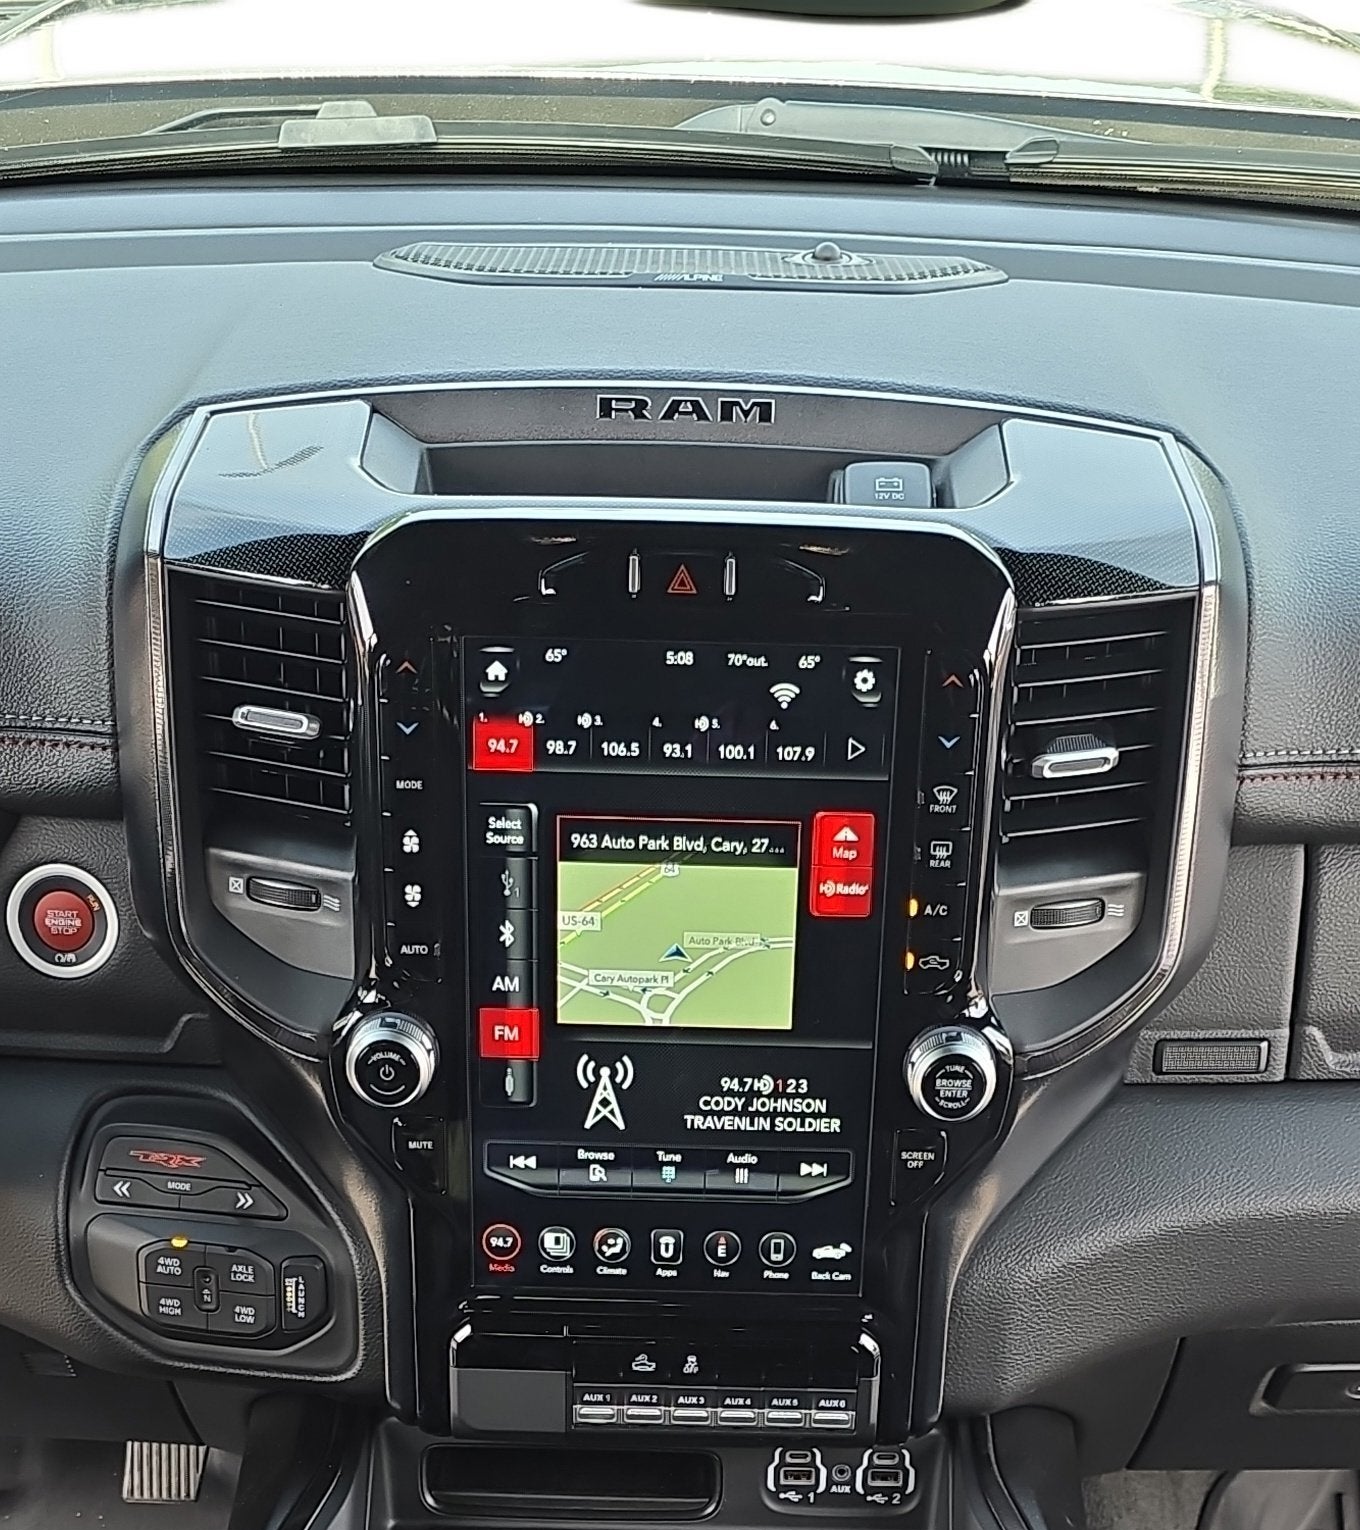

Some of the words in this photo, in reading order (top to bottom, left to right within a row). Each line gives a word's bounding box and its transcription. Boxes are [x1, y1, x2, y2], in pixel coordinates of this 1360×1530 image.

[596, 394, 776, 424] RAM
[874, 492, 890, 500] 12V
[892, 492, 905, 500] DC
[545, 648, 568, 662] 65°
[665, 651, 694, 665] 5:08
[798, 655, 821, 669] 65°
[487, 738, 519, 753] 94.7
[546, 740, 577, 755] 98.7
[601, 741, 640, 757] 106.5
[663, 743, 692, 759] 93.1
[718, 744, 755, 760] 100.1
[776, 745, 815, 761] 107.9
[396, 780, 424, 790] MODE
[929, 804, 957, 813] FRONT
[488, 816, 522, 830] Select
[485, 832, 525, 845] Source
[570, 833, 598, 849] 963
[601, 834, 635, 850] Auto
[639, 836, 669, 850] Park
[673, 836, 707, 854] Blvd,
[710, 837, 748, 855] Cary,
[832, 847, 857, 861] Map
[929, 860, 952, 868] REAR
[46, 910, 78, 918] START
[924, 904, 948, 916] A/C
[45, 918, 82, 927] ENGINE
[562, 916, 595, 926] US-64
[50, 926, 78, 935] STOP
[688, 935, 712, 946] Auto
[713, 936, 734, 946] Park
[400, 945, 429, 955] AUTO
[492, 976, 520, 992] AM
[594, 974, 615, 985] Cary
[616, 974, 659, 985] Autopark
[494, 1026, 520, 1041] FM
[371, 1052, 401, 1062] VOLUME
[945, 1064, 966, 1073] TUNE
[720, 1077, 753, 1092] 94.7
[786, 1079, 796, 1093] 2
[798, 1079, 808, 1094] 3
[935, 1079, 972, 1088] BROWSE
[940, 1089, 968, 1098] ENTER
[699, 1096, 745, 1112] CODY
[748, 1097, 827, 1113] JOHNSON
[938, 1099, 967, 1109] SCROLL
[684, 1115, 770, 1131] TRAVENLIN
[774, 1117, 841, 1133] SOLDIER
[408, 1141, 434, 1150] MUTE
[577, 1149, 615, 1161] Browse
[656, 1151, 682, 1163] Tune
[726, 1153, 758, 1164] Audio
[901, 1151, 935, 1161] SCREEN
[907, 1160, 924, 1169] OFF
[167, 1181, 191, 1191] MODE
[490, 1237, 514, 1248] 94.7
[157, 1257, 180, 1267] 4WD
[157, 1266, 182, 1276] AUTO
[231, 1264, 254, 1274] AXLE
[540, 1264, 574, 1275] Controls
[596, 1265, 627, 1276] Climate
[656, 1267, 677, 1278] Apps
[763, 1269, 790, 1280] Phone
[231, 1273, 255, 1283] LOCK
[811, 1271, 831, 1281] Back
[297, 1276, 306, 1318] LAUNCH
[159, 1298, 180, 1308] 4WD
[159, 1305, 182, 1316] HIGH
[234, 1306, 255, 1315] 4WD
[235, 1314, 255, 1324] LOW
[583, 1393, 604, 1402] AUX
[630, 1394, 651, 1403] AUX
[677, 1396, 698, 1404] AUX
[724, 1397, 745, 1406] AUX
[771, 1398, 792, 1407] AUX
[818, 1399, 839, 1408] AUX
[829, 1485, 851, 1494] AUX
[807, 1492, 815, 1503] 1
[892, 1493, 901, 1504] 2
